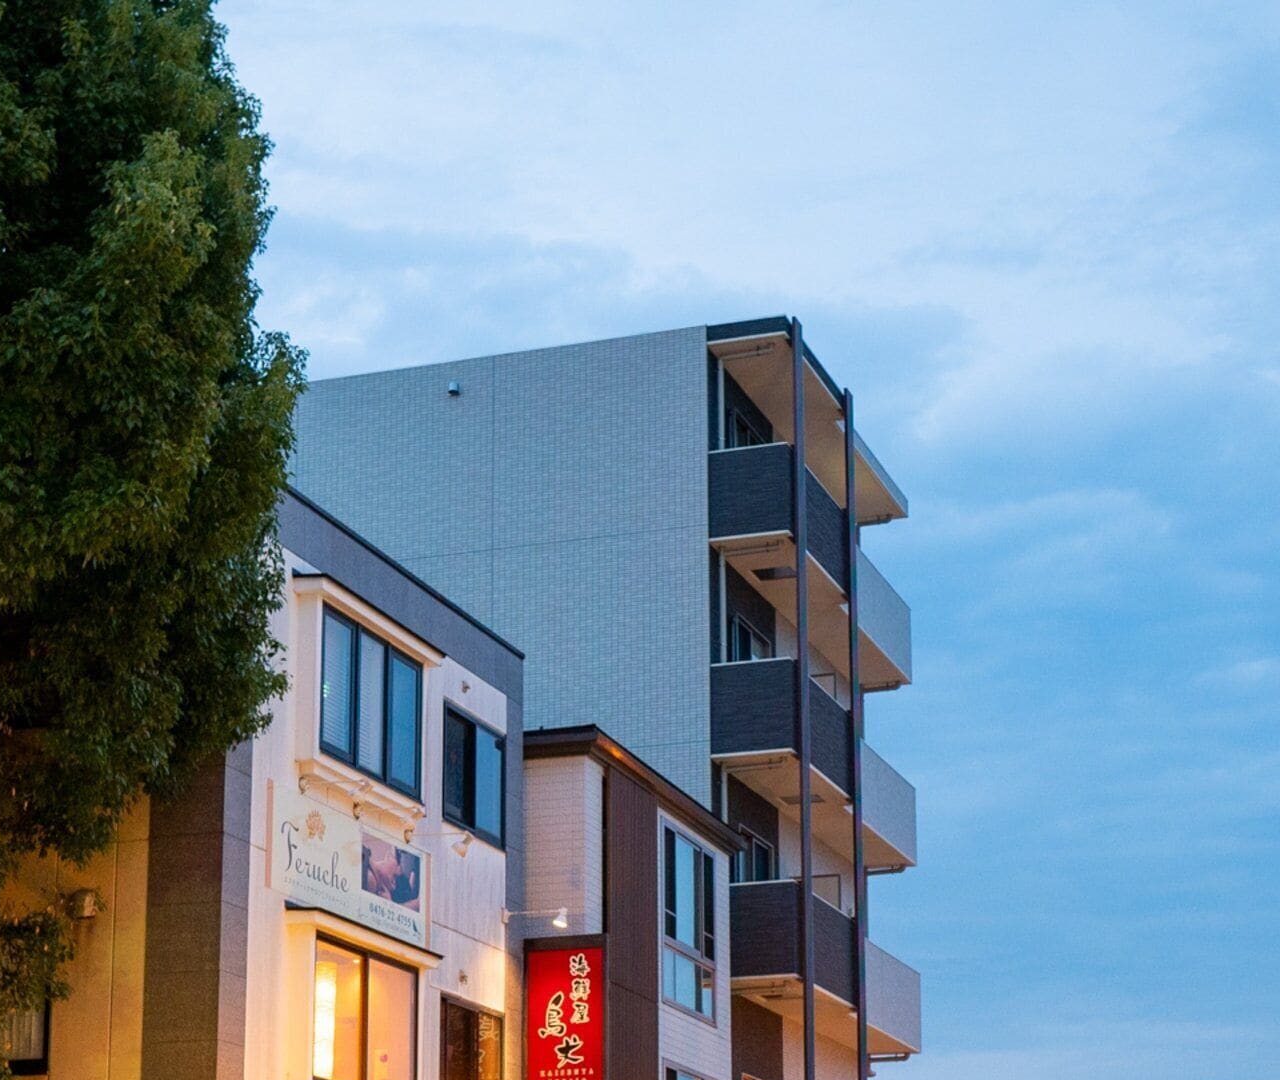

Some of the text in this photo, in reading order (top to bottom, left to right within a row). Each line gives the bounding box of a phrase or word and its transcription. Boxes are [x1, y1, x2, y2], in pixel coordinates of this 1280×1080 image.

[281, 820, 350, 893] Feruche
[569, 953, 591, 1024] 海鮮屋
